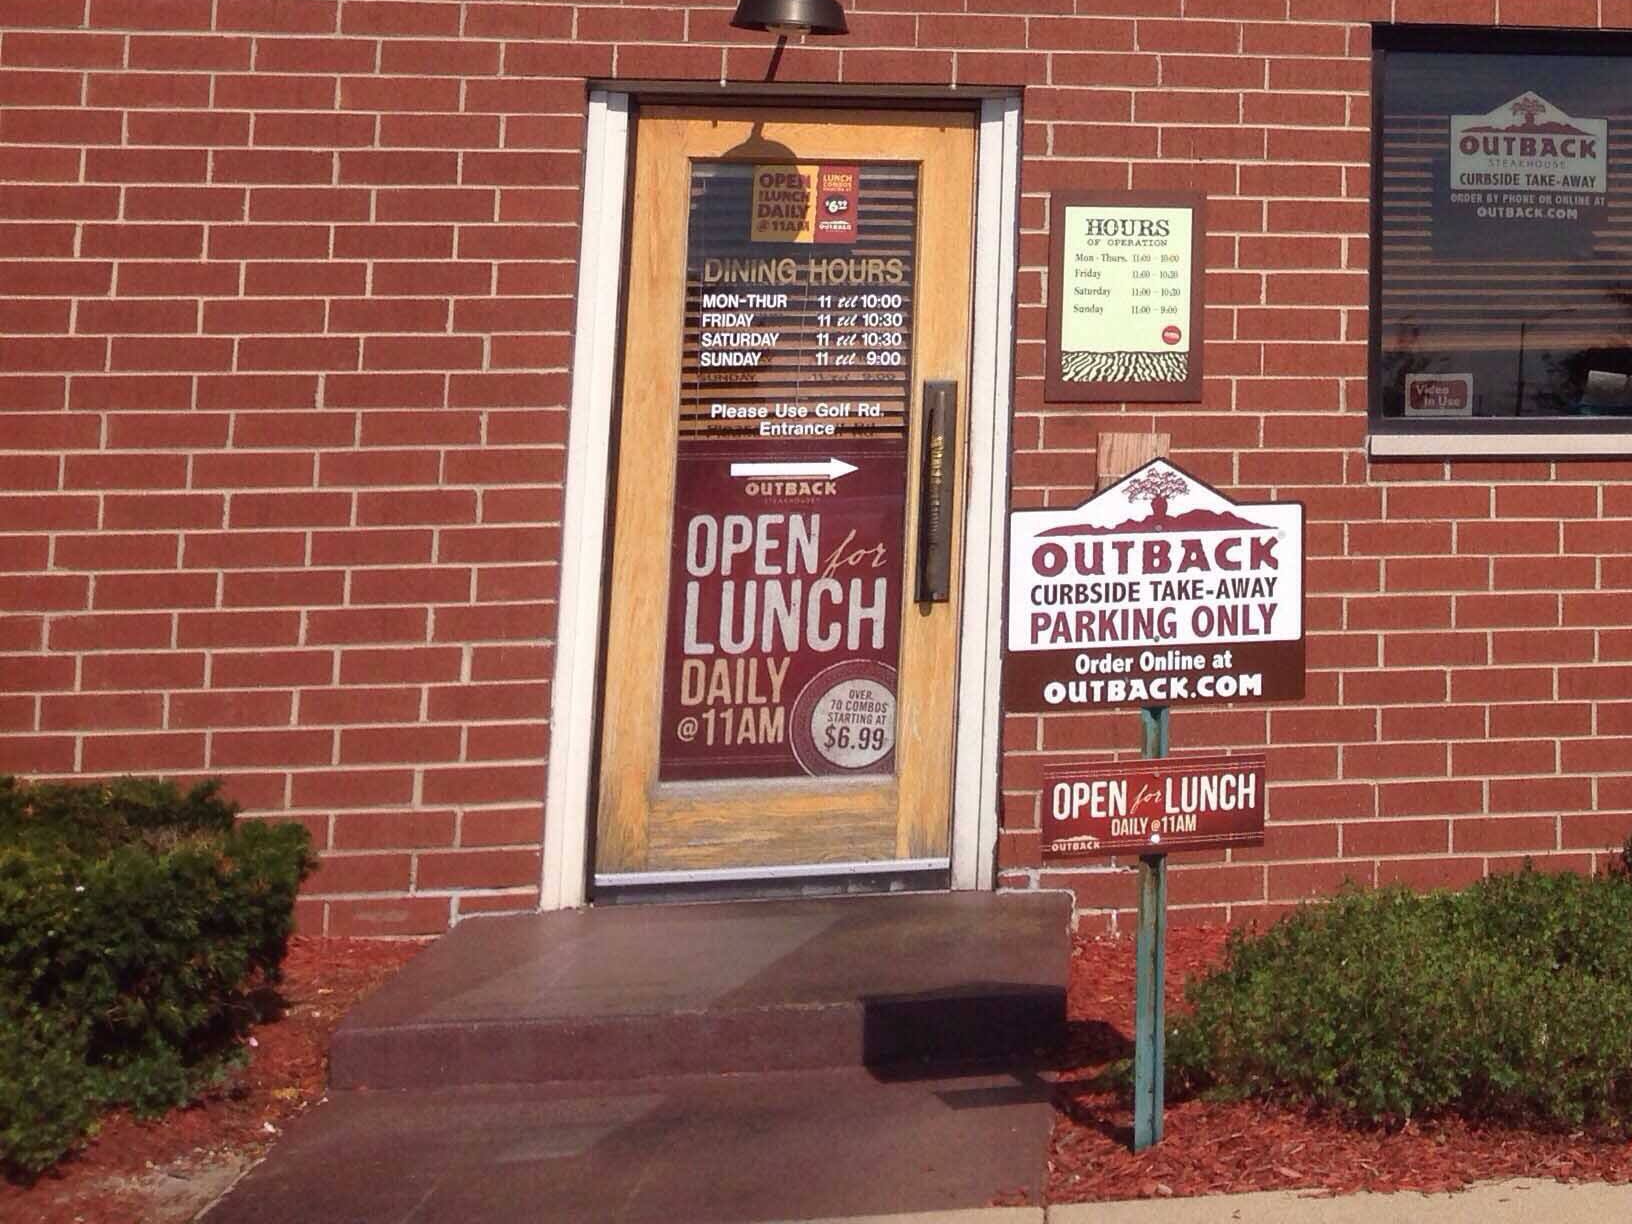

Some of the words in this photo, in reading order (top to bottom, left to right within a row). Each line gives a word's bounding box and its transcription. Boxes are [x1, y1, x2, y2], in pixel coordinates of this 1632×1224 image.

[1459, 136, 1597, 159] OUTBACK
[1488, 160, 1567, 169] STEAKHOUSE
[760, 173, 811, 188] OPEN
[823, 174, 853, 182] LUNCH
[1460, 173, 1521, 186] CURBSIDE
[1525, 174, 1597, 188] TAKE-AWAY
[1451, 192, 1482, 203] ORDER
[1487, 193, 1498, 204] BY
[1502, 194, 1534, 204] PHONE
[1539, 195, 1552, 205] OR
[1555, 195, 1590, 206] ONLINE
[1594, 196, 1605, 206] AT
[758, 204, 810, 219] DAILY
[1085, 218, 1170, 237] HOURS
[1107, 239, 1168, 247] OPERATION
[1075, 254, 1094, 262] Mon
[704, 258, 797, 284] DINING
[809, 258, 903, 284] HOURS
[1075, 268, 1101, 279] Friday
[1074, 286, 1111, 297] Saturday
[703, 294, 787, 308] MON-THUR
[818, 295, 831, 308] 11
[862, 294, 901, 308] 10:00
[1073, 304, 1104, 314] Sunday
[702, 313, 754, 327] FRIDAY
[817, 314, 831, 327] 11
[862, 313, 903, 327] 10:30
[701, 333, 779, 347] SATURDAY
[816, 333, 830, 346] 11
[862, 333, 902, 346] 10:30
[701, 352, 762, 366] SUNDAY
[816, 352, 828, 365] 11
[866, 352, 901, 365] 9:00
[711, 404, 768, 418] Please
[775, 404, 808, 417] Use
[815, 403, 850, 417] Golf
[858, 403, 884, 417] Rd.
[759, 422, 836, 436] Entrance
[745, 482, 837, 496] OUTBACK
[686, 514, 820, 576] OPEN
[820, 528, 888, 580] for
[1031, 536, 1279, 577] OUTBACK
[1031, 582, 1141, 606] CURBSIDE
[1150, 577, 1279, 602] TAKE-AWAY
[683, 577, 888, 654] LUNCH
[1031, 606, 1176, 644] PARKING
[1191, 603, 1278, 638] ONLY
[1075, 652, 1133, 674] Order
[1140, 650, 1205, 672] Online
[1213, 651, 1233, 670] at
[681, 657, 791, 705] DAILY
[849, 689, 873, 700] OVER
[1044, 674, 1262, 704] OUTBACK.COM
[831, 699, 843, 710] 70
[845, 700, 888, 713] COMBOS
[827, 712, 873, 724] STARTING
[876, 715, 887, 725] AT
[824, 723, 884, 752] $6.99
[1052, 780, 1127, 820] OPEN
[1130, 784, 1163, 814] for
[1165, 773, 1256, 813] LUNCH
[1111, 817, 1149, 836] DAILY
[1051, 842, 1100, 852] OUTBACK
